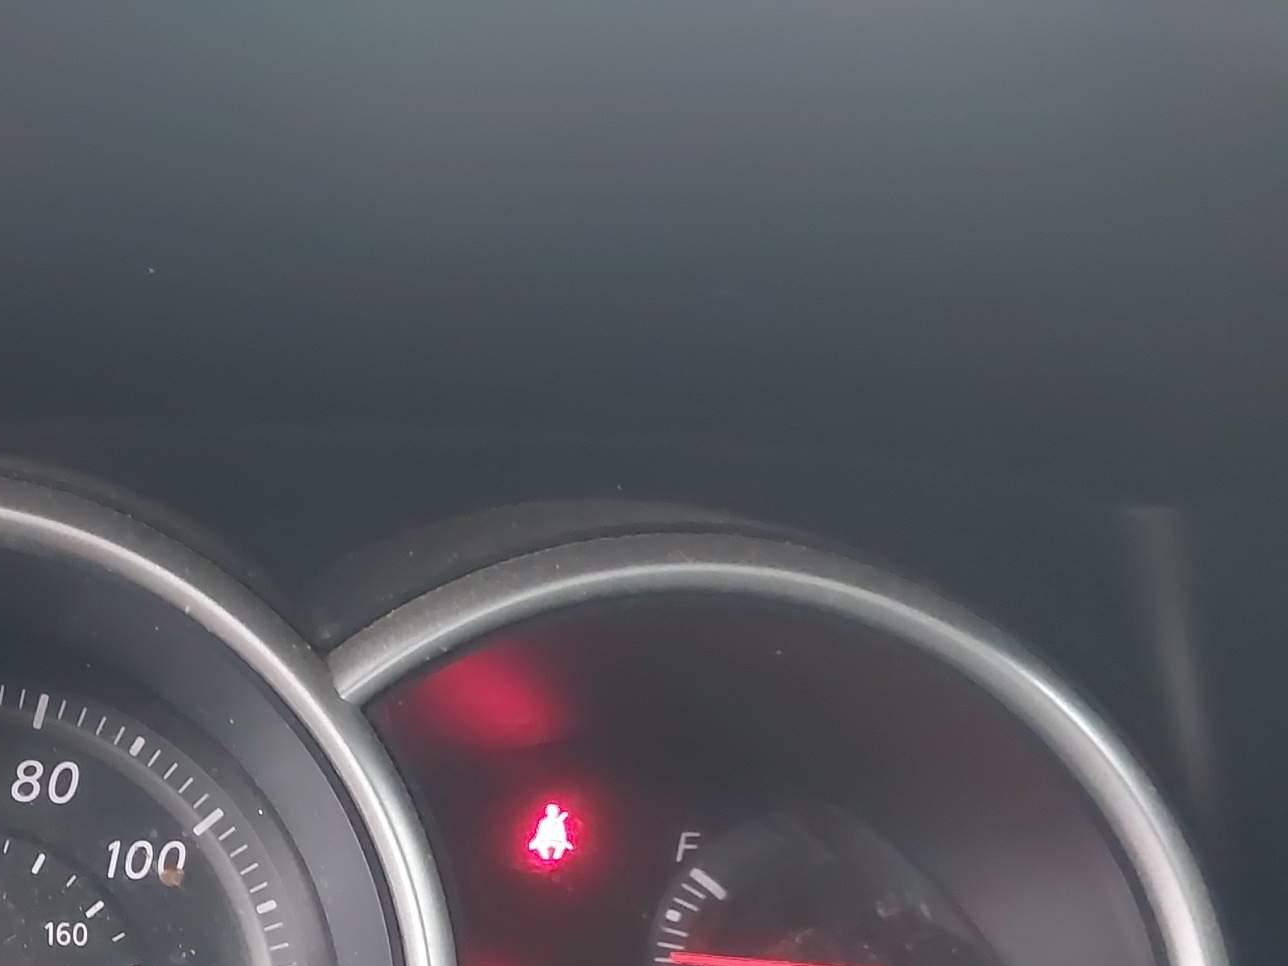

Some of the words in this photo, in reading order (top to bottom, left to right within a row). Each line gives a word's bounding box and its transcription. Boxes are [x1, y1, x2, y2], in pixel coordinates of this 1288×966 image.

[11, 760, 80, 804] 80
[107, 840, 186, 880] 100
[676, 832, 701, 862] F
[44, 922, 87, 946] 160
